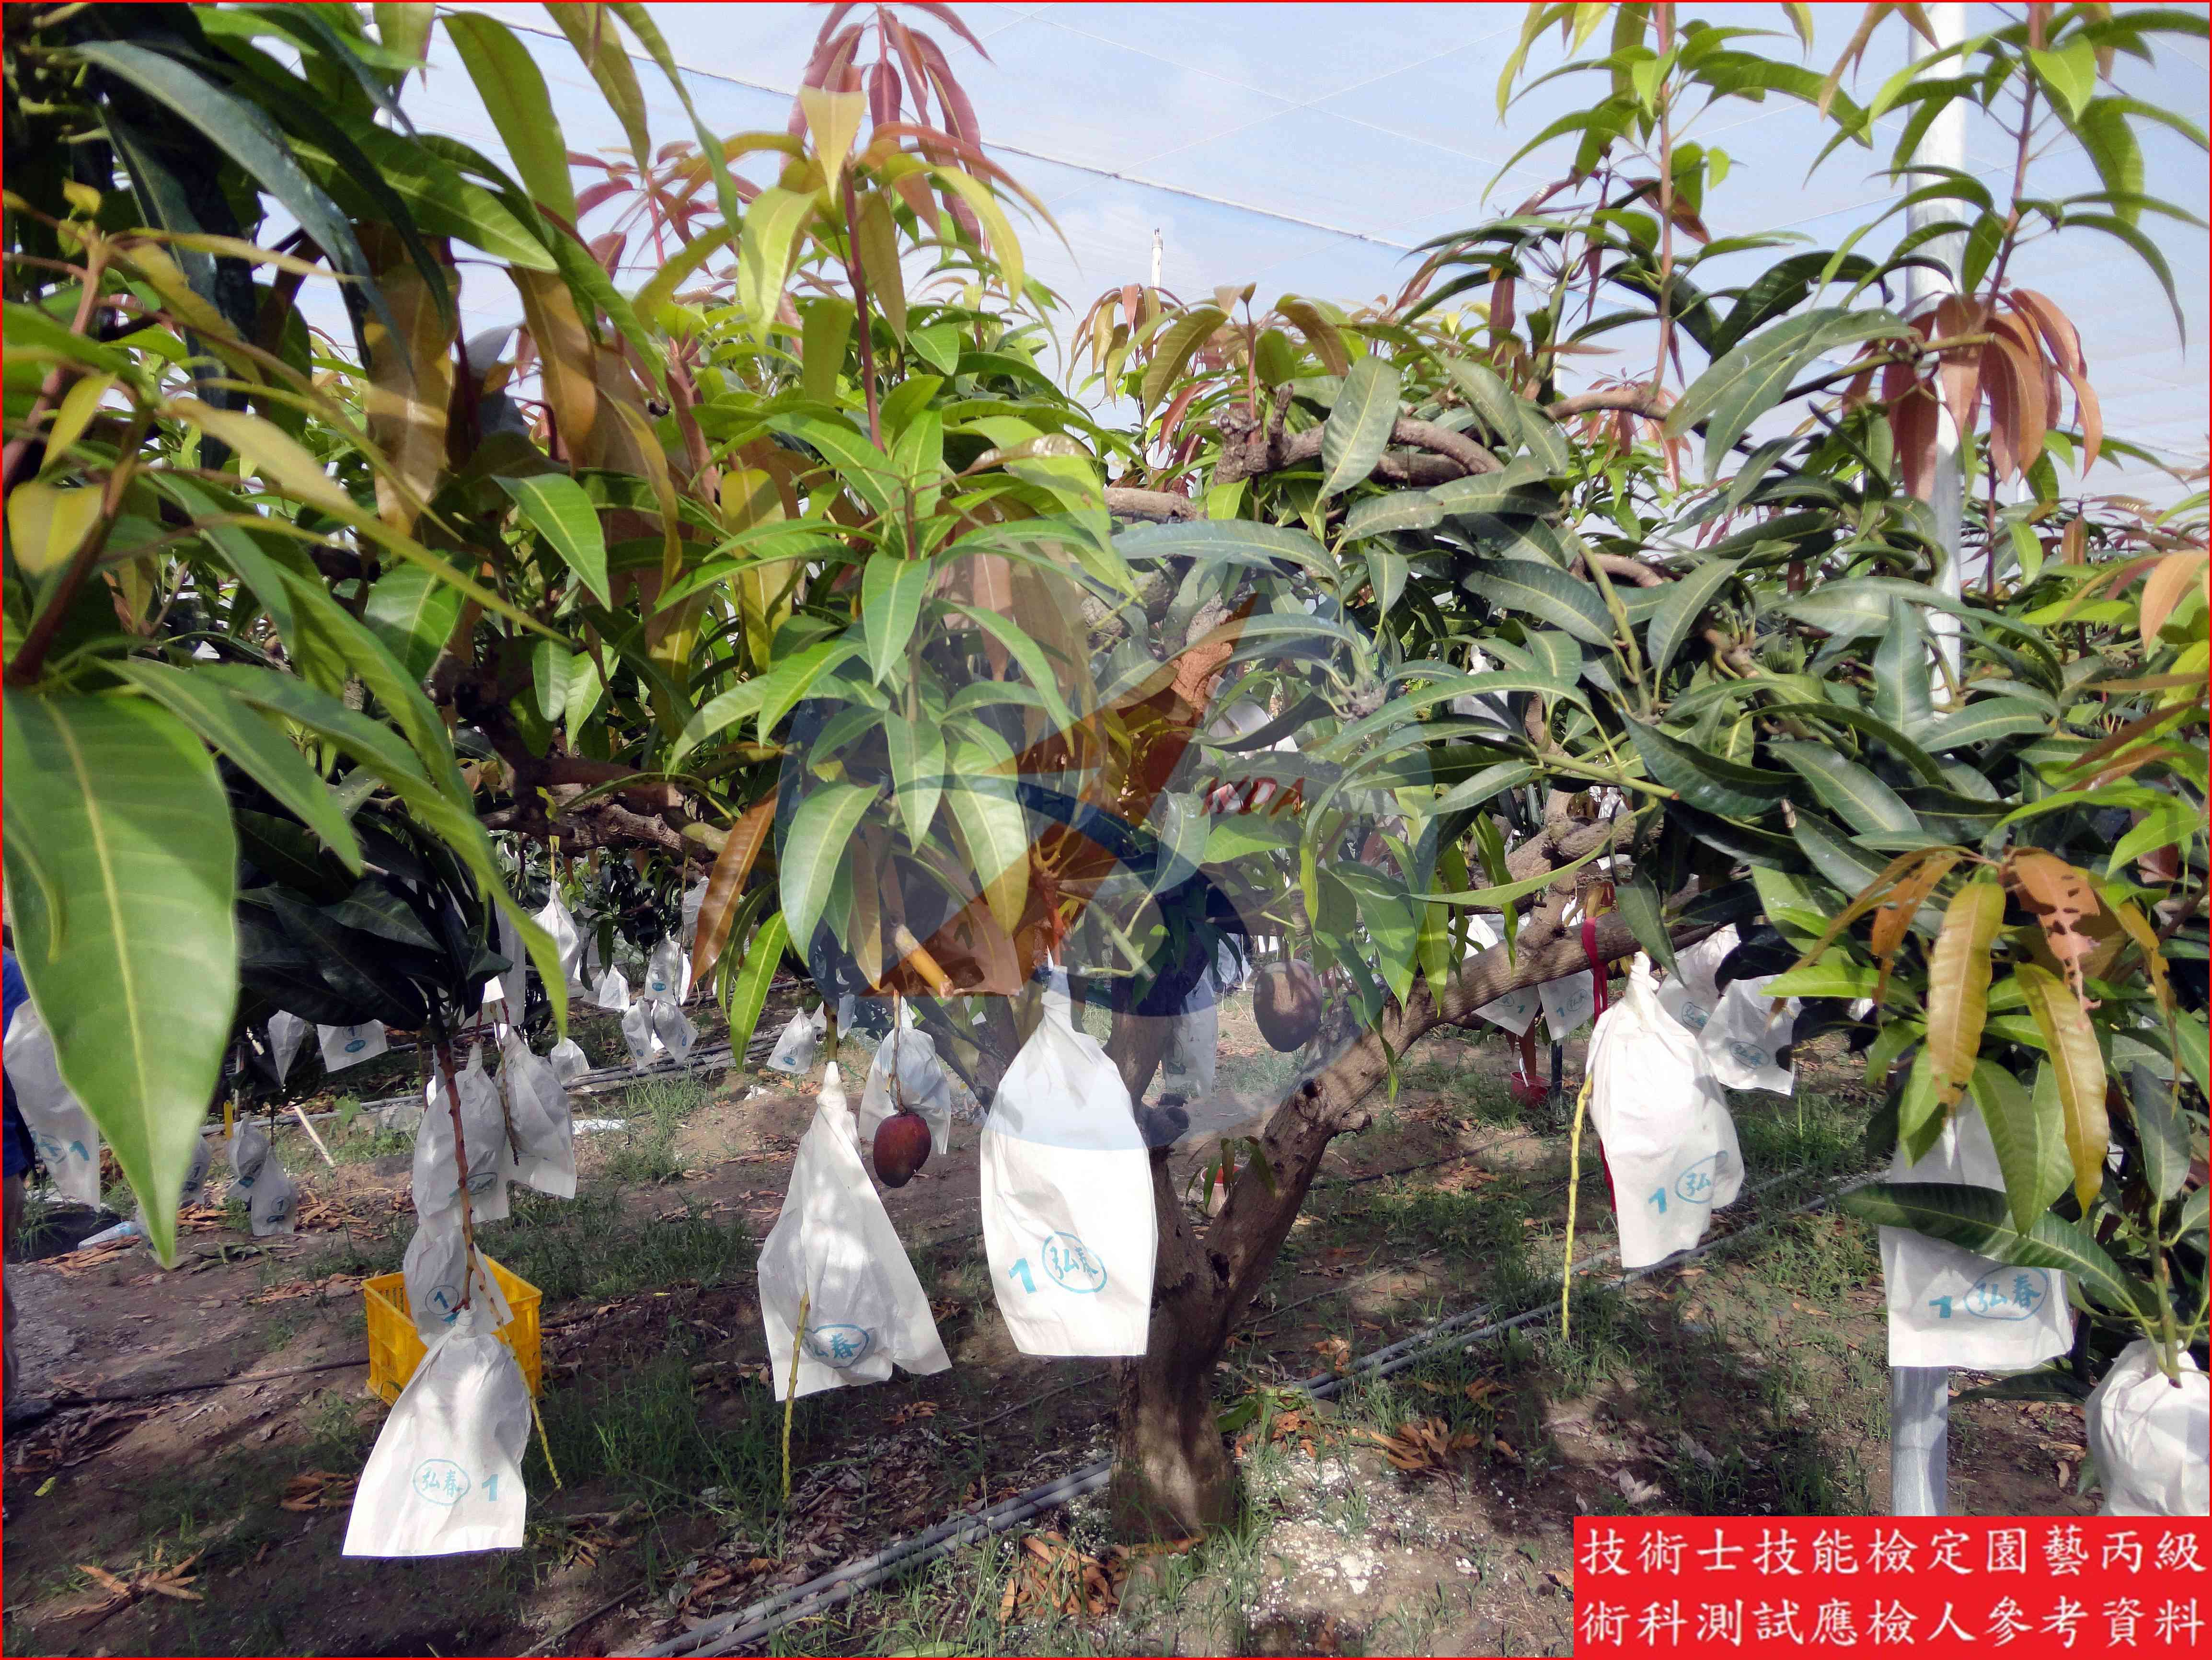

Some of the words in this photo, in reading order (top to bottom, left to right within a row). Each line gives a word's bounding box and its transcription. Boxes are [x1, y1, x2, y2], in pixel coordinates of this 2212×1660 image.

[1648, 1187, 1667, 1212] 1
[1008, 1257, 1037, 1294] 1
[434, 1291, 449, 1309] 1
[1929, 1295, 1952, 1318] 1
[1976, 1273, 2041, 1312] 弘春
[481, 1473, 499, 1501] 1
